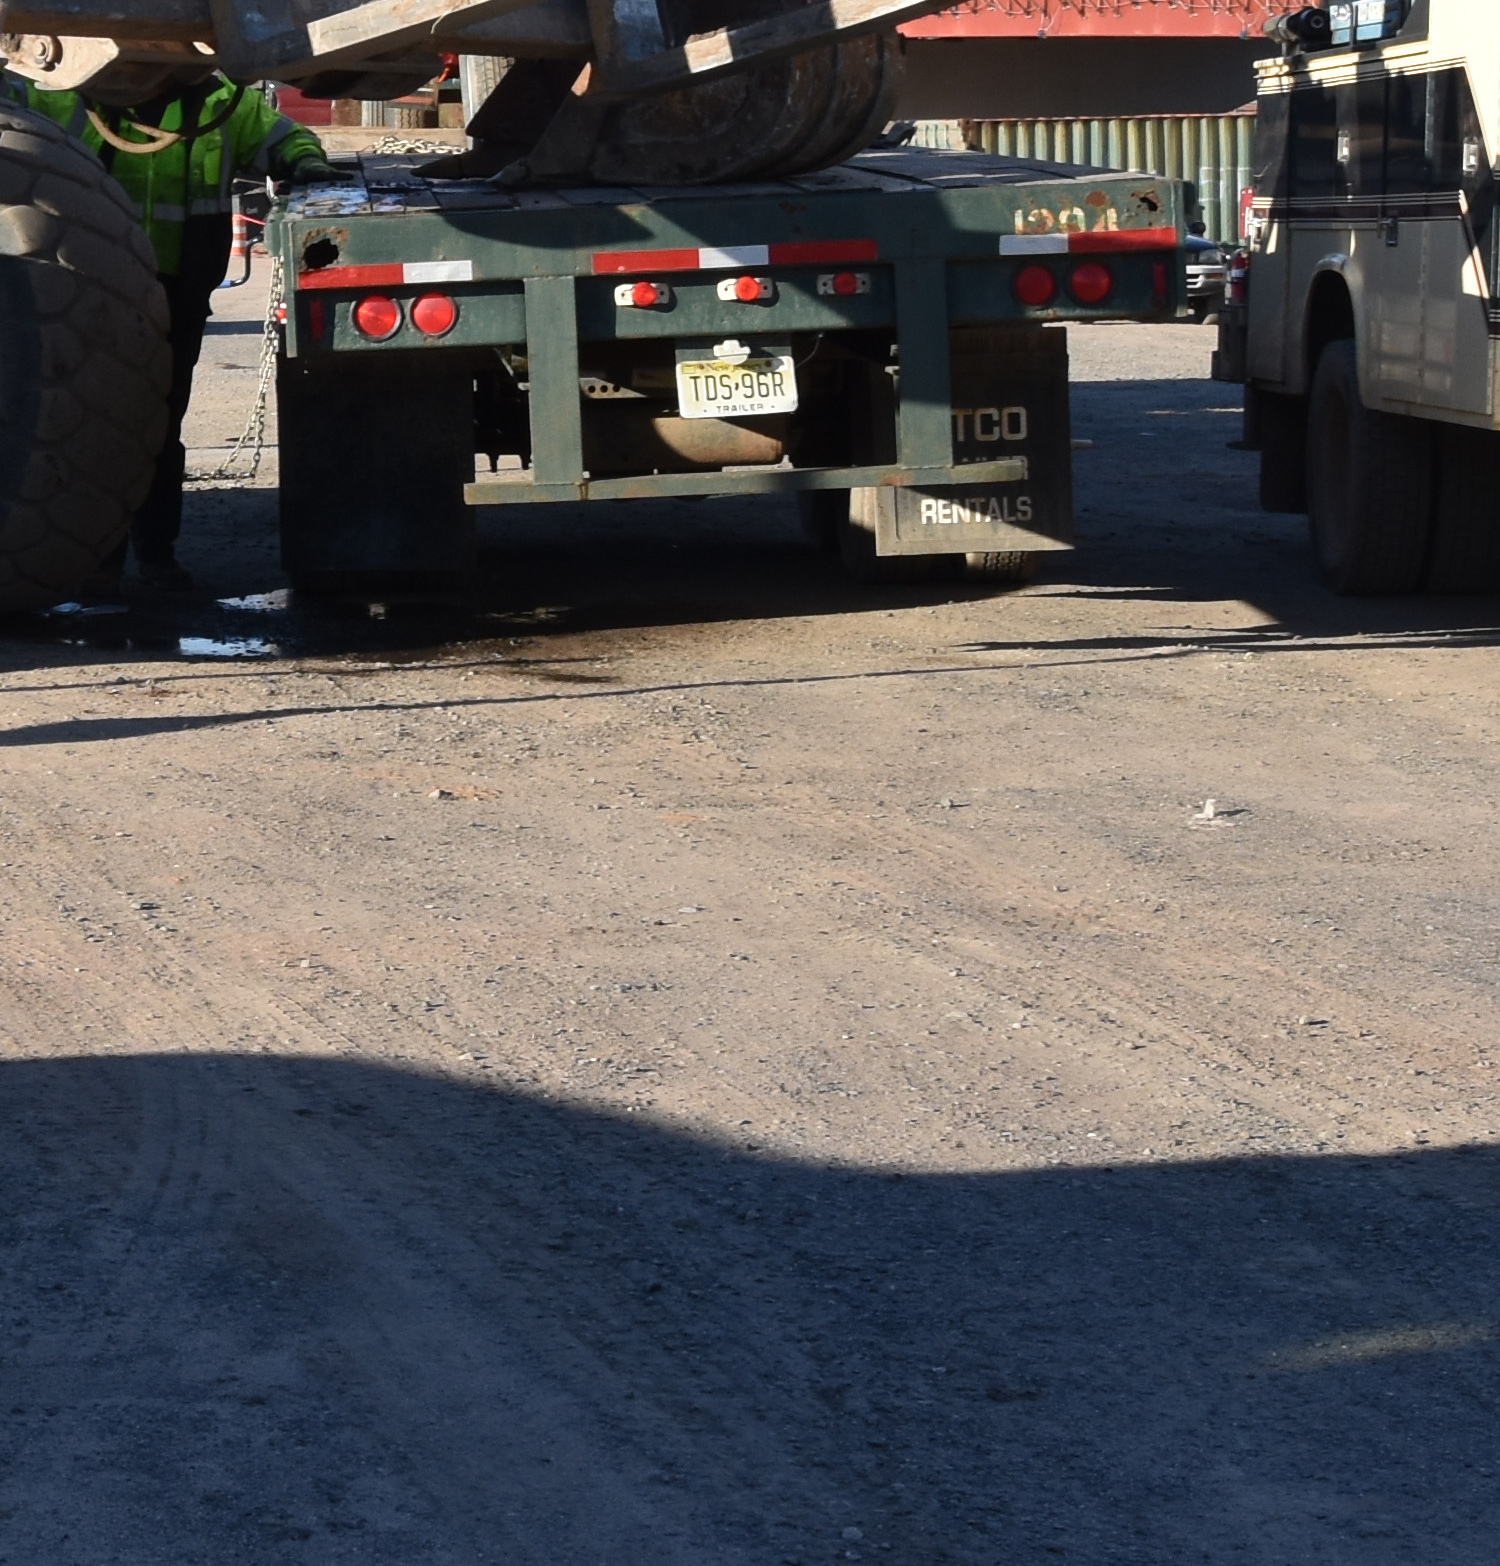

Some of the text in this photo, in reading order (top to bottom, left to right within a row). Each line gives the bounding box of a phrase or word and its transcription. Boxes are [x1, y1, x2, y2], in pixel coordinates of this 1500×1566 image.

[715, 403, 764, 413] TRAILER
[951, 406, 1028, 442] TCO
[921, 496, 1032, 524] RENTALS
